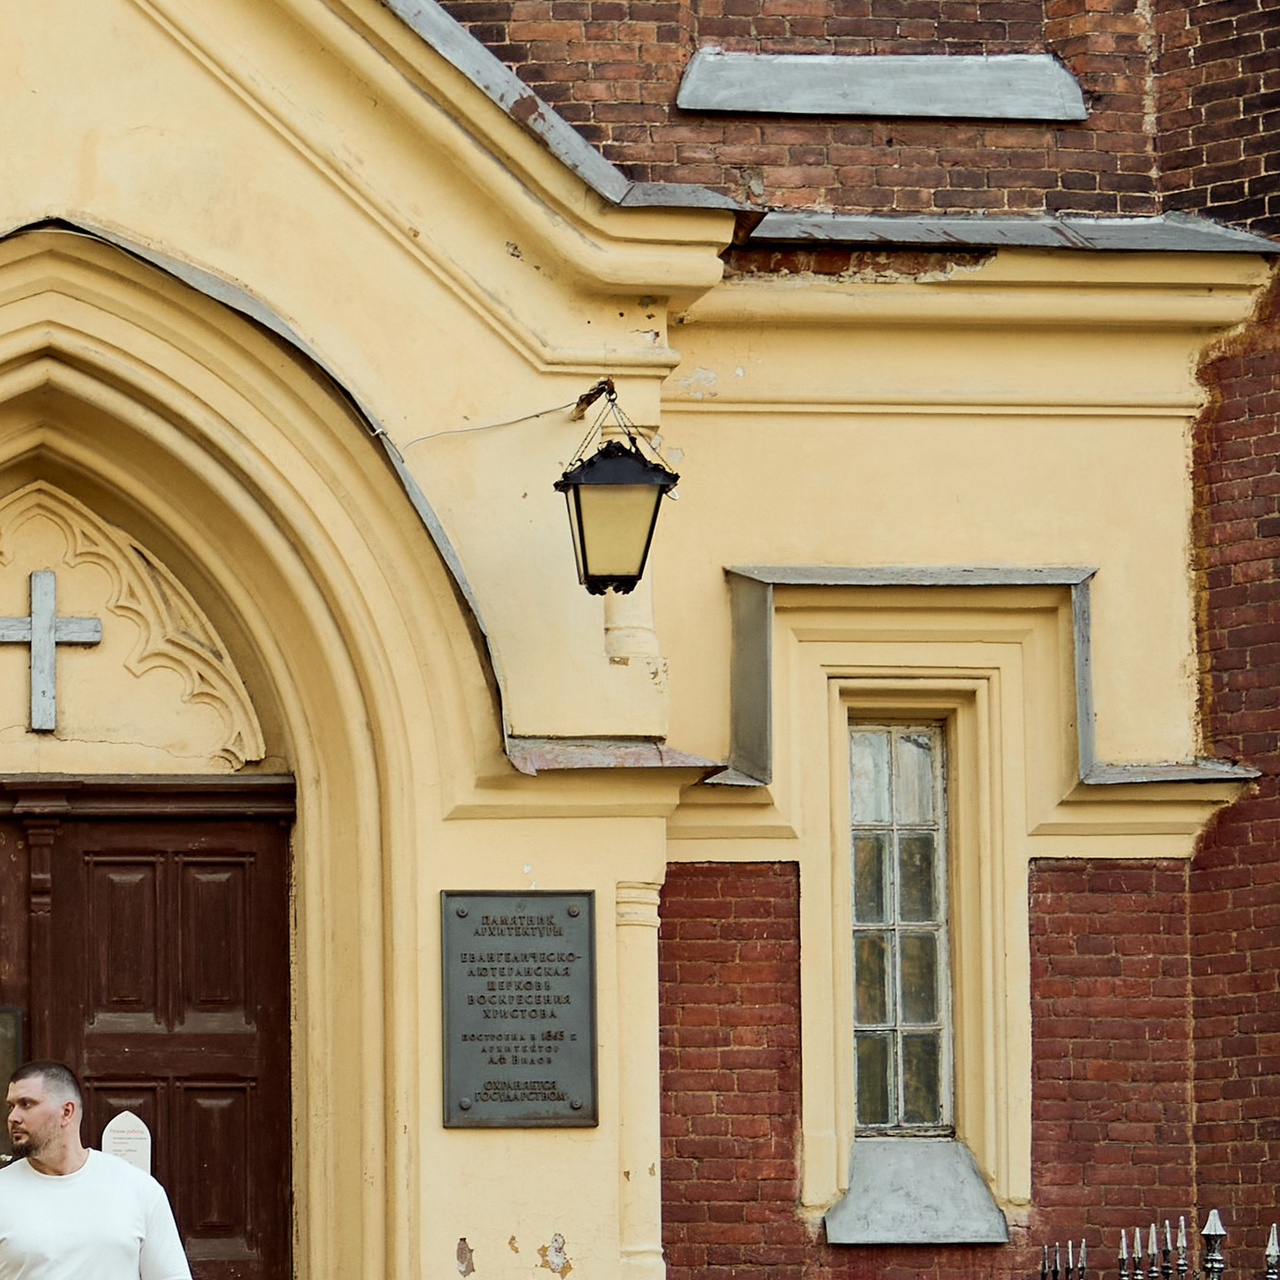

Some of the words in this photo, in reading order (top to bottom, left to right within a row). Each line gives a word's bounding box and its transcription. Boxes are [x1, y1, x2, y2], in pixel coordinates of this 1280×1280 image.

[481, 915, 555, 926] ПАМЯТНИК
[473, 926, 563, 937] АРХИТЕКТУРЫ
[460, 953, 582, 963] ЕВАНГЕЛИЧЕСКО-
[468, 967, 571, 977] ЛЮТЕРАНСКАЯ
[486, 981, 551, 991] ЦЕРКОВЬ
[468, 995, 571, 1005] ВОСКРЕСЕНИЯ
[483, 1009, 557, 1019] ХРИСТОВА
[483, 1081, 558, 1091] ОХРАНЯЕТСЯ
[475, 1092, 567, 1103] ГОСУДАРСТВОМ
